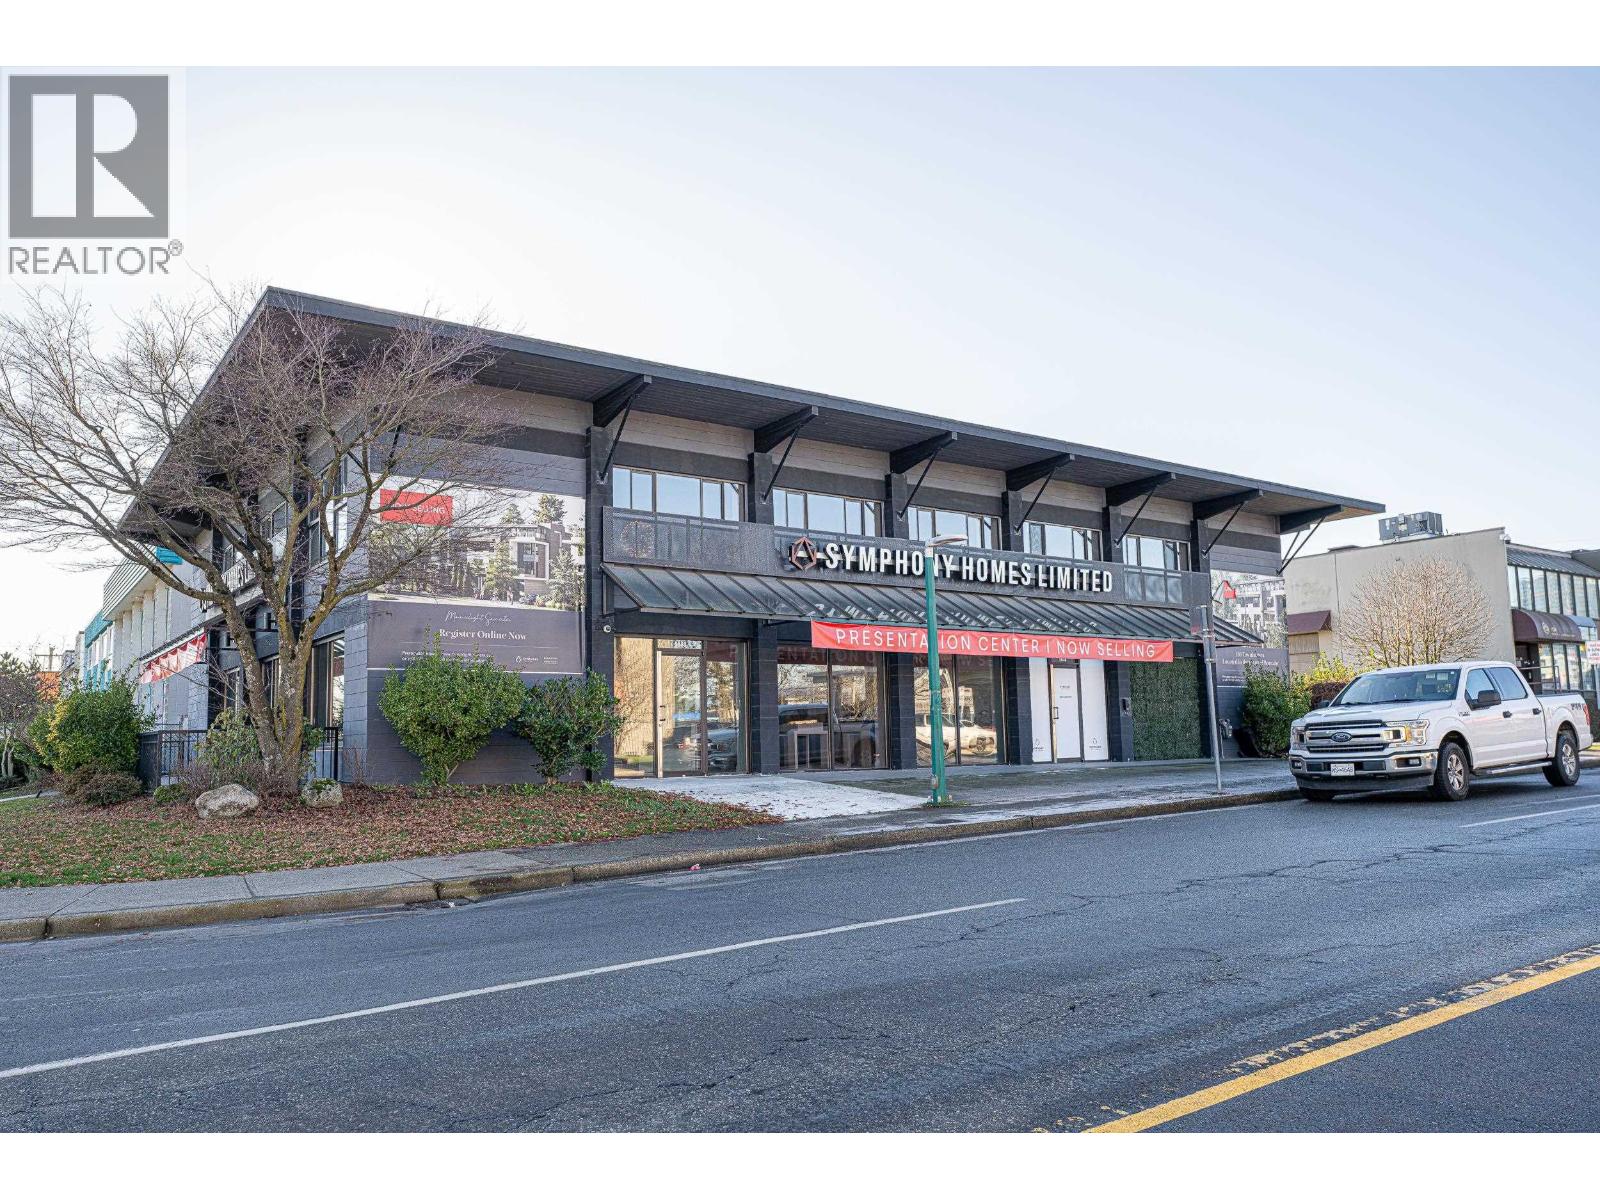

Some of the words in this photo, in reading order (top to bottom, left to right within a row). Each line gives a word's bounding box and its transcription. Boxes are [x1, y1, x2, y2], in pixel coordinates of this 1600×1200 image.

[962, 556, 1032, 586] HOMES
[1038, 564, 1113, 593] LIMITED
[439, 628, 476, 641] Register
[477, 630, 508, 640] Online
[508, 631, 527, 641] Now
[836, 629, 971, 651] PRESENTAION
[978, 636, 1039, 654] CENTER
[1057, 640, 1091, 655] NOW
[1097, 642, 1156, 658] SELLING
